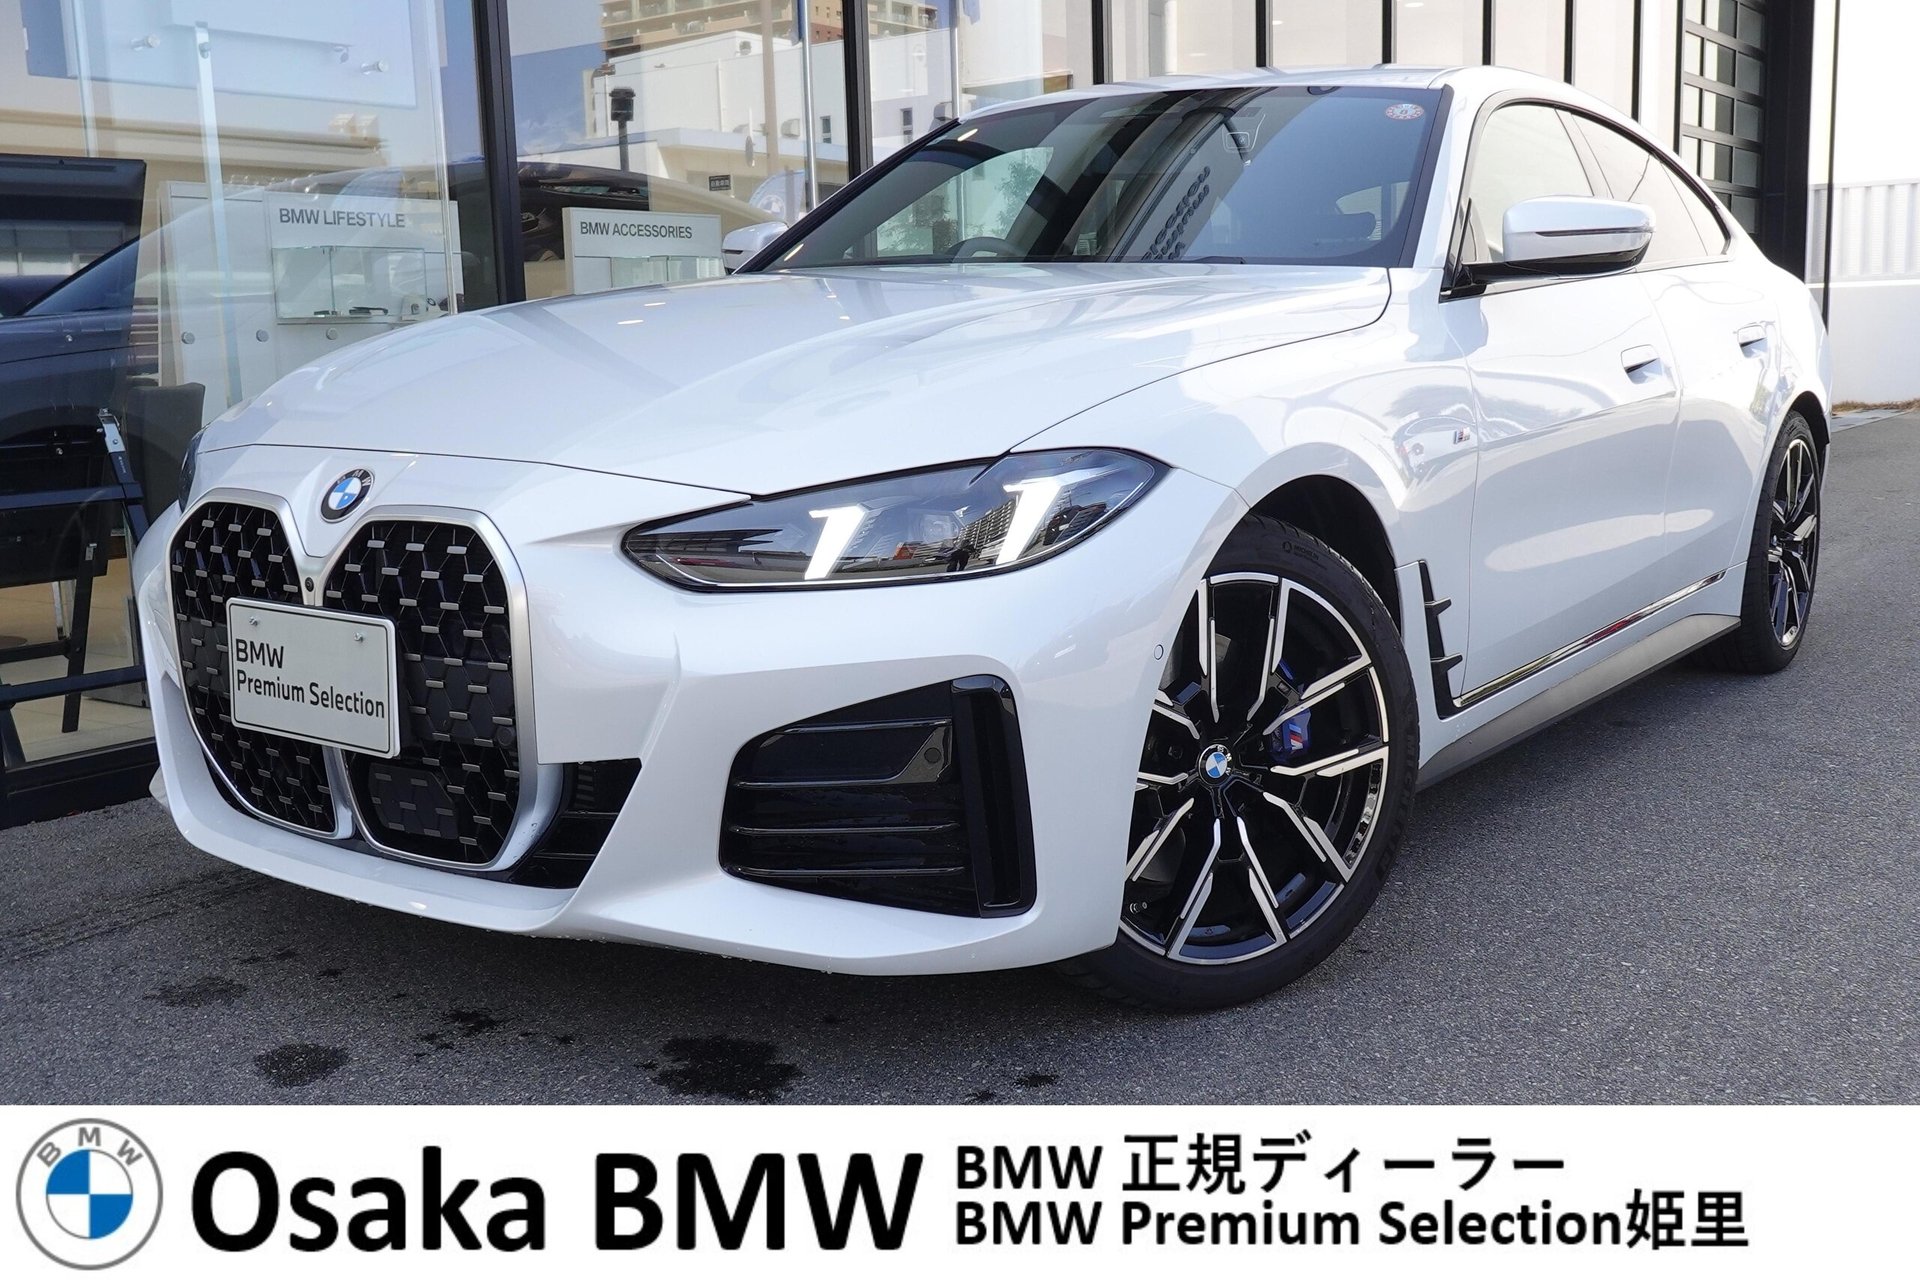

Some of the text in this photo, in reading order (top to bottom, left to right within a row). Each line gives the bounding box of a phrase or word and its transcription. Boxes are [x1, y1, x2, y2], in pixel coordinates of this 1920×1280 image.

[279, 208, 406, 228] BMW LIFESTYLE
[580, 221, 693, 239] BMW ACCESSORIES
[235, 638, 285, 669] BMW
[237, 669, 385, 719] Premium Selection
